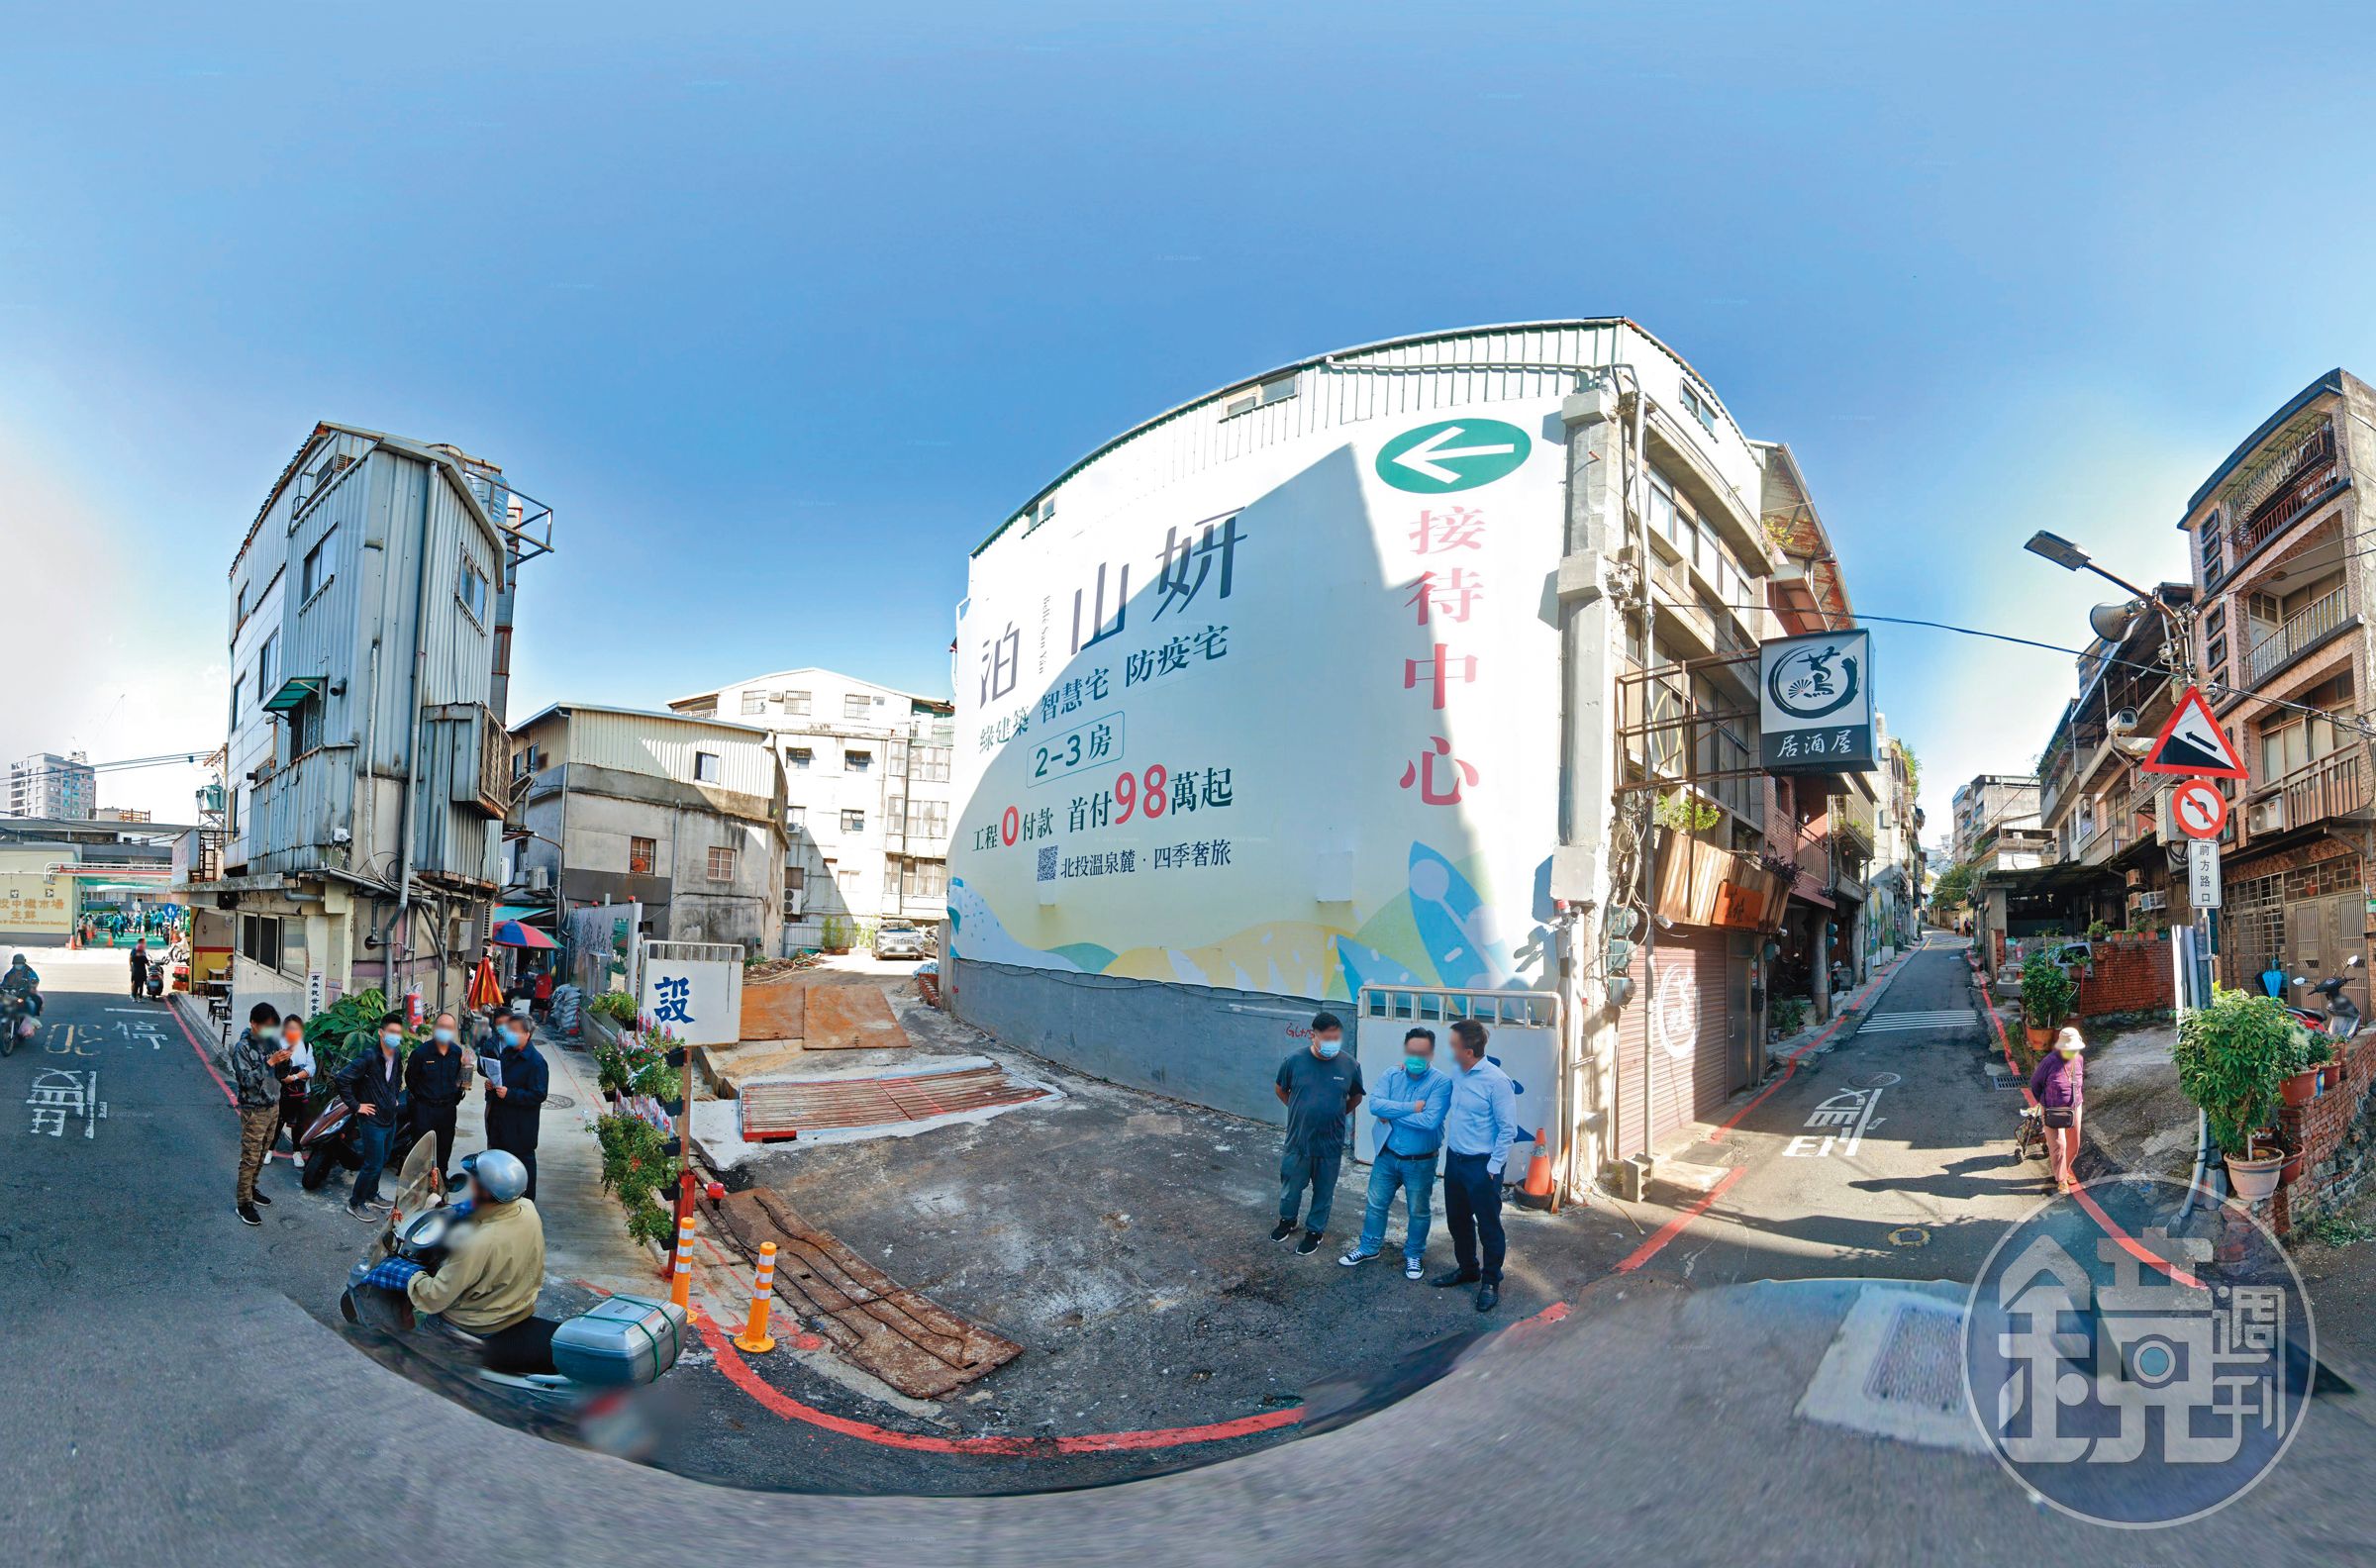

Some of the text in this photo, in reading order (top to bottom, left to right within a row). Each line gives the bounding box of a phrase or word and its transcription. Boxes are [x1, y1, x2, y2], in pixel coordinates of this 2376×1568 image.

[979, 625, 1230, 754] 綠建築 智慧宅 防疫宅
[1399, 506, 1487, 806] 接待中心
[1777, 729, 1852, 758] 居酒屋
[1068, 764, 1234, 834] 首付98萬起
[2199, 844, 2211, 903] 前方路口
[654, 976, 695, 1024] 設
[26, 1067, 108, 1138] 慢
[1782, 1088, 1887, 1157] 慢
